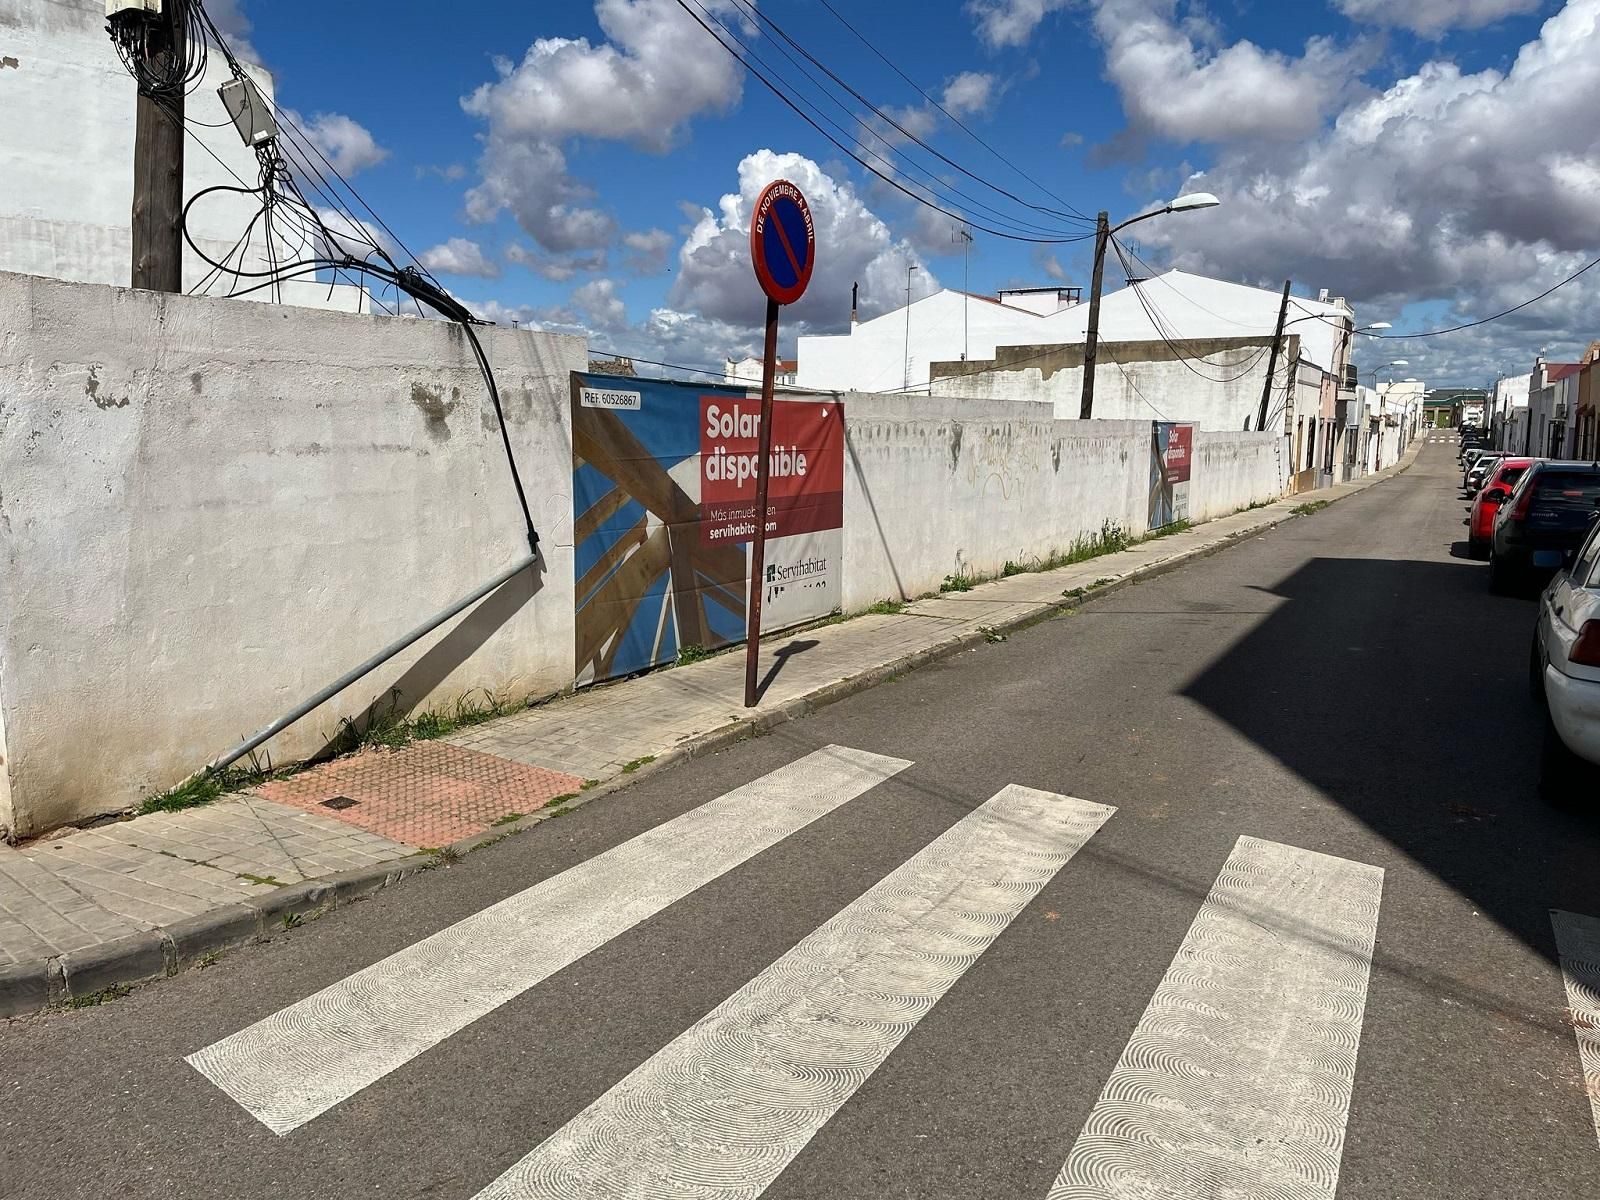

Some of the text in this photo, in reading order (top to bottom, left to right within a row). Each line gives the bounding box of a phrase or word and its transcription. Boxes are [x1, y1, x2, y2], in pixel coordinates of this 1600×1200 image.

[756, 185, 814, 242] DE NOVIEMBRE A ABRIL
[584, 392, 637, 406] REF. 60526867
[706, 404, 761, 439] Solar
[766, 506, 776, 516] en
[777, 557, 827, 580] Servihabitat
